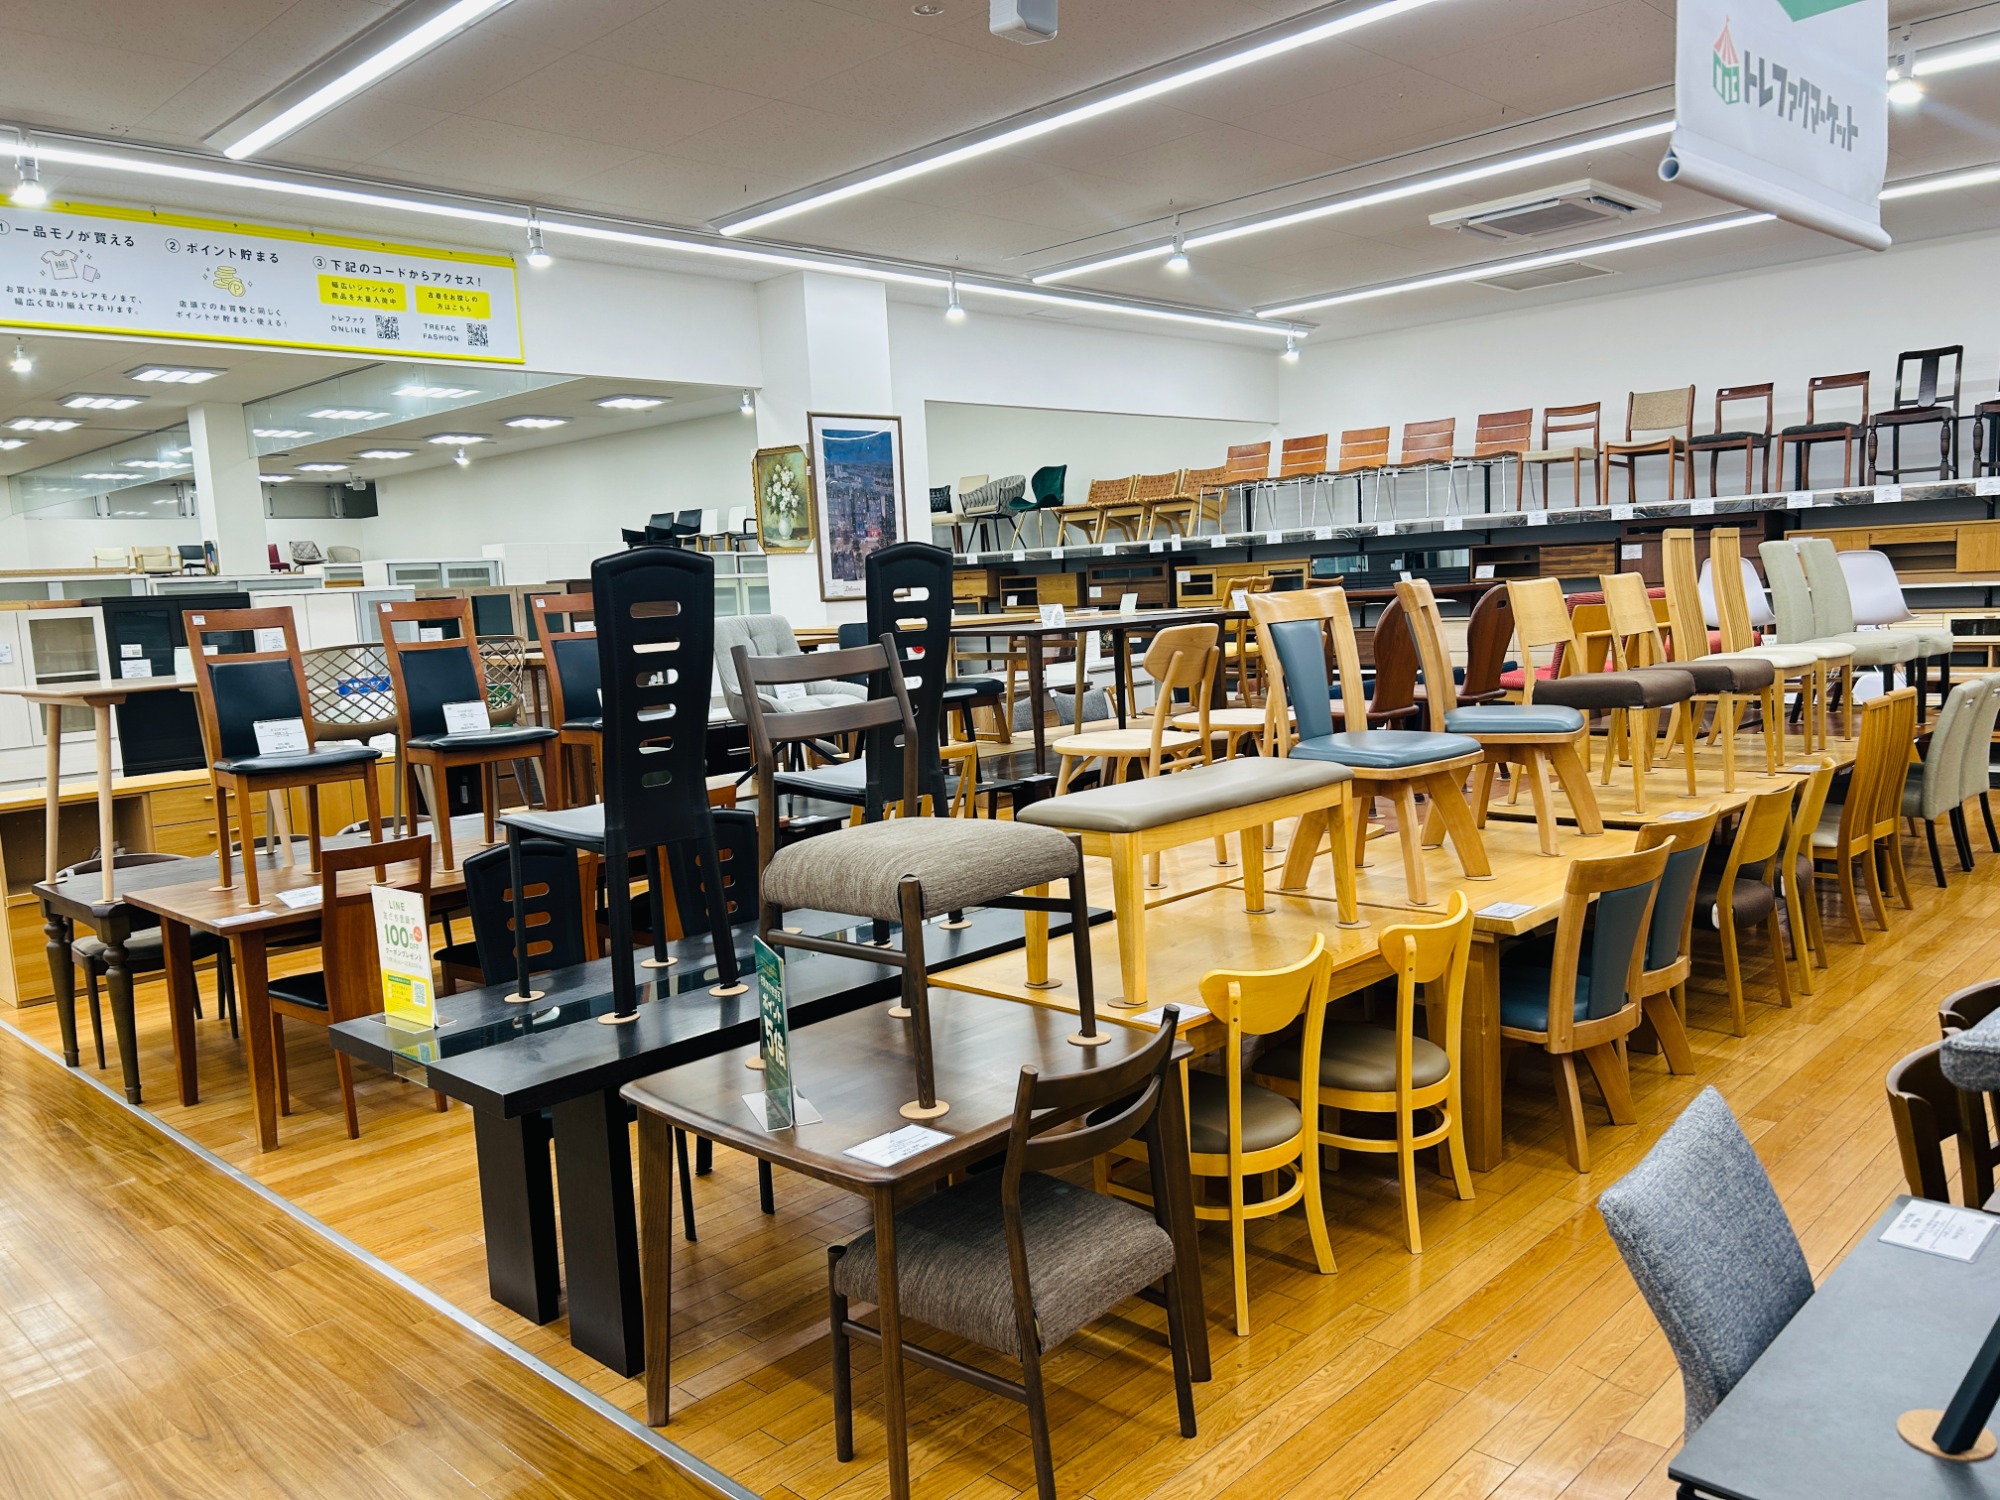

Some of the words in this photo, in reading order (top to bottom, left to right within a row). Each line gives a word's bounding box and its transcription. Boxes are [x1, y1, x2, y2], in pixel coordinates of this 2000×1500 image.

[1744, 50, 1859, 152] トレファクマーケット
[15, 225, 135, 248] 一品モノが買える
[186, 243, 280, 264] ポイント貯まる
[330, 325, 367, 335] ONLINE
[423, 323, 456, 332] TREFAC
[422, 333, 460, 342] FASHION
[388, 900, 405, 912] LINE
